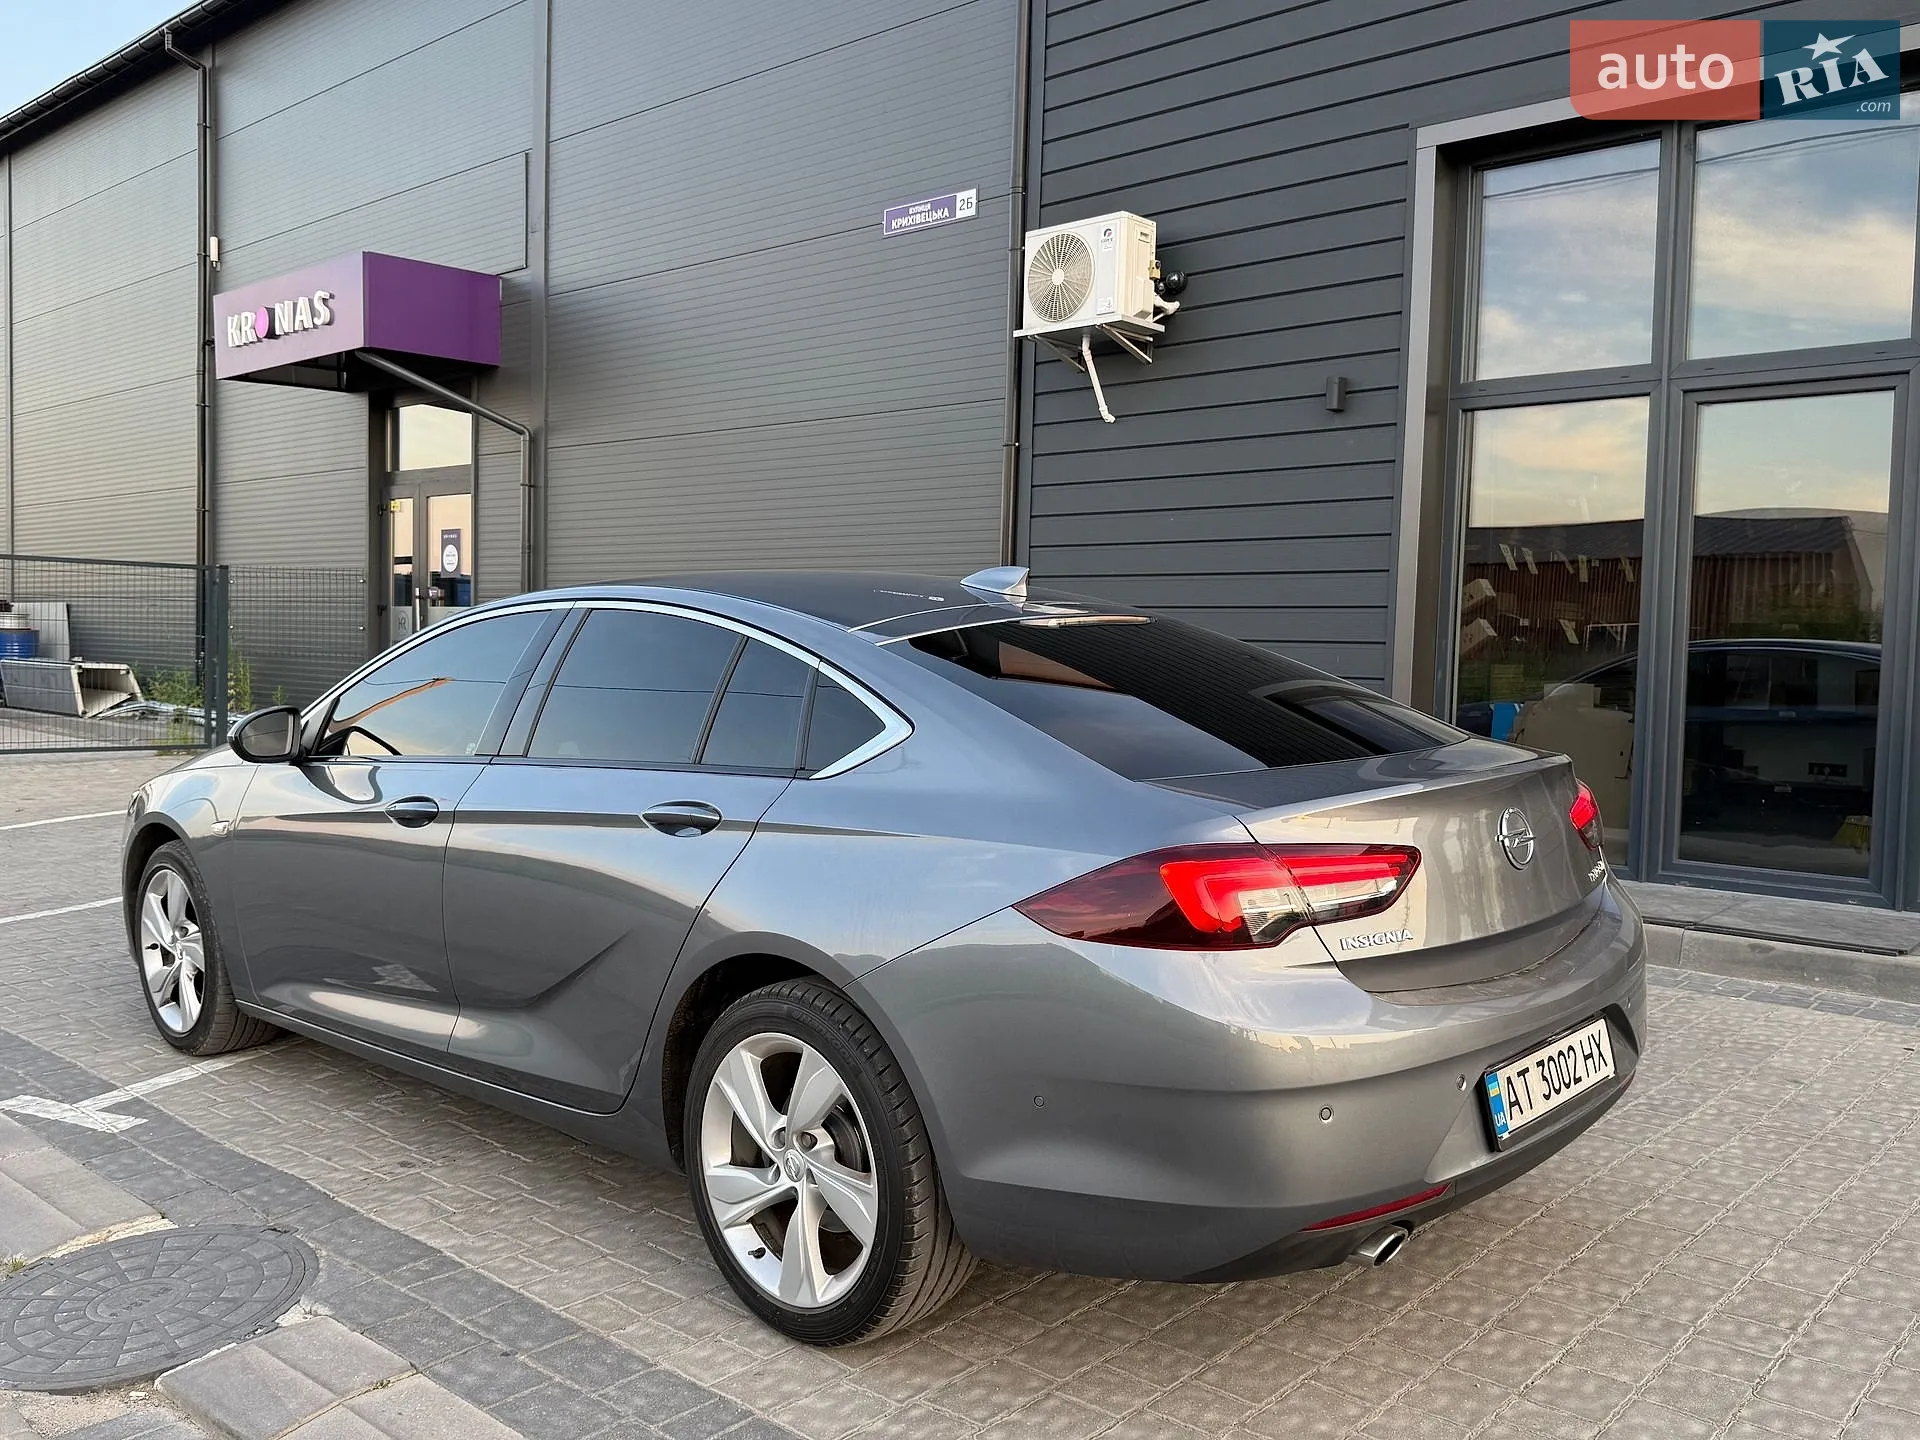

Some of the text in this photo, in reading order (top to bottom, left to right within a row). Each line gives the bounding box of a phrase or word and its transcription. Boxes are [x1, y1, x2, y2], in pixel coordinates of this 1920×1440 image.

[959, 197, 973, 211] 2Б
[891, 207, 949, 230] КРИХІВЕЦЬКА
[1340, 928, 1414, 951] INSIGNIA
[1506, 1029, 1608, 1121] AT 3002 HX
[1494, 1111, 1507, 1127] UA
